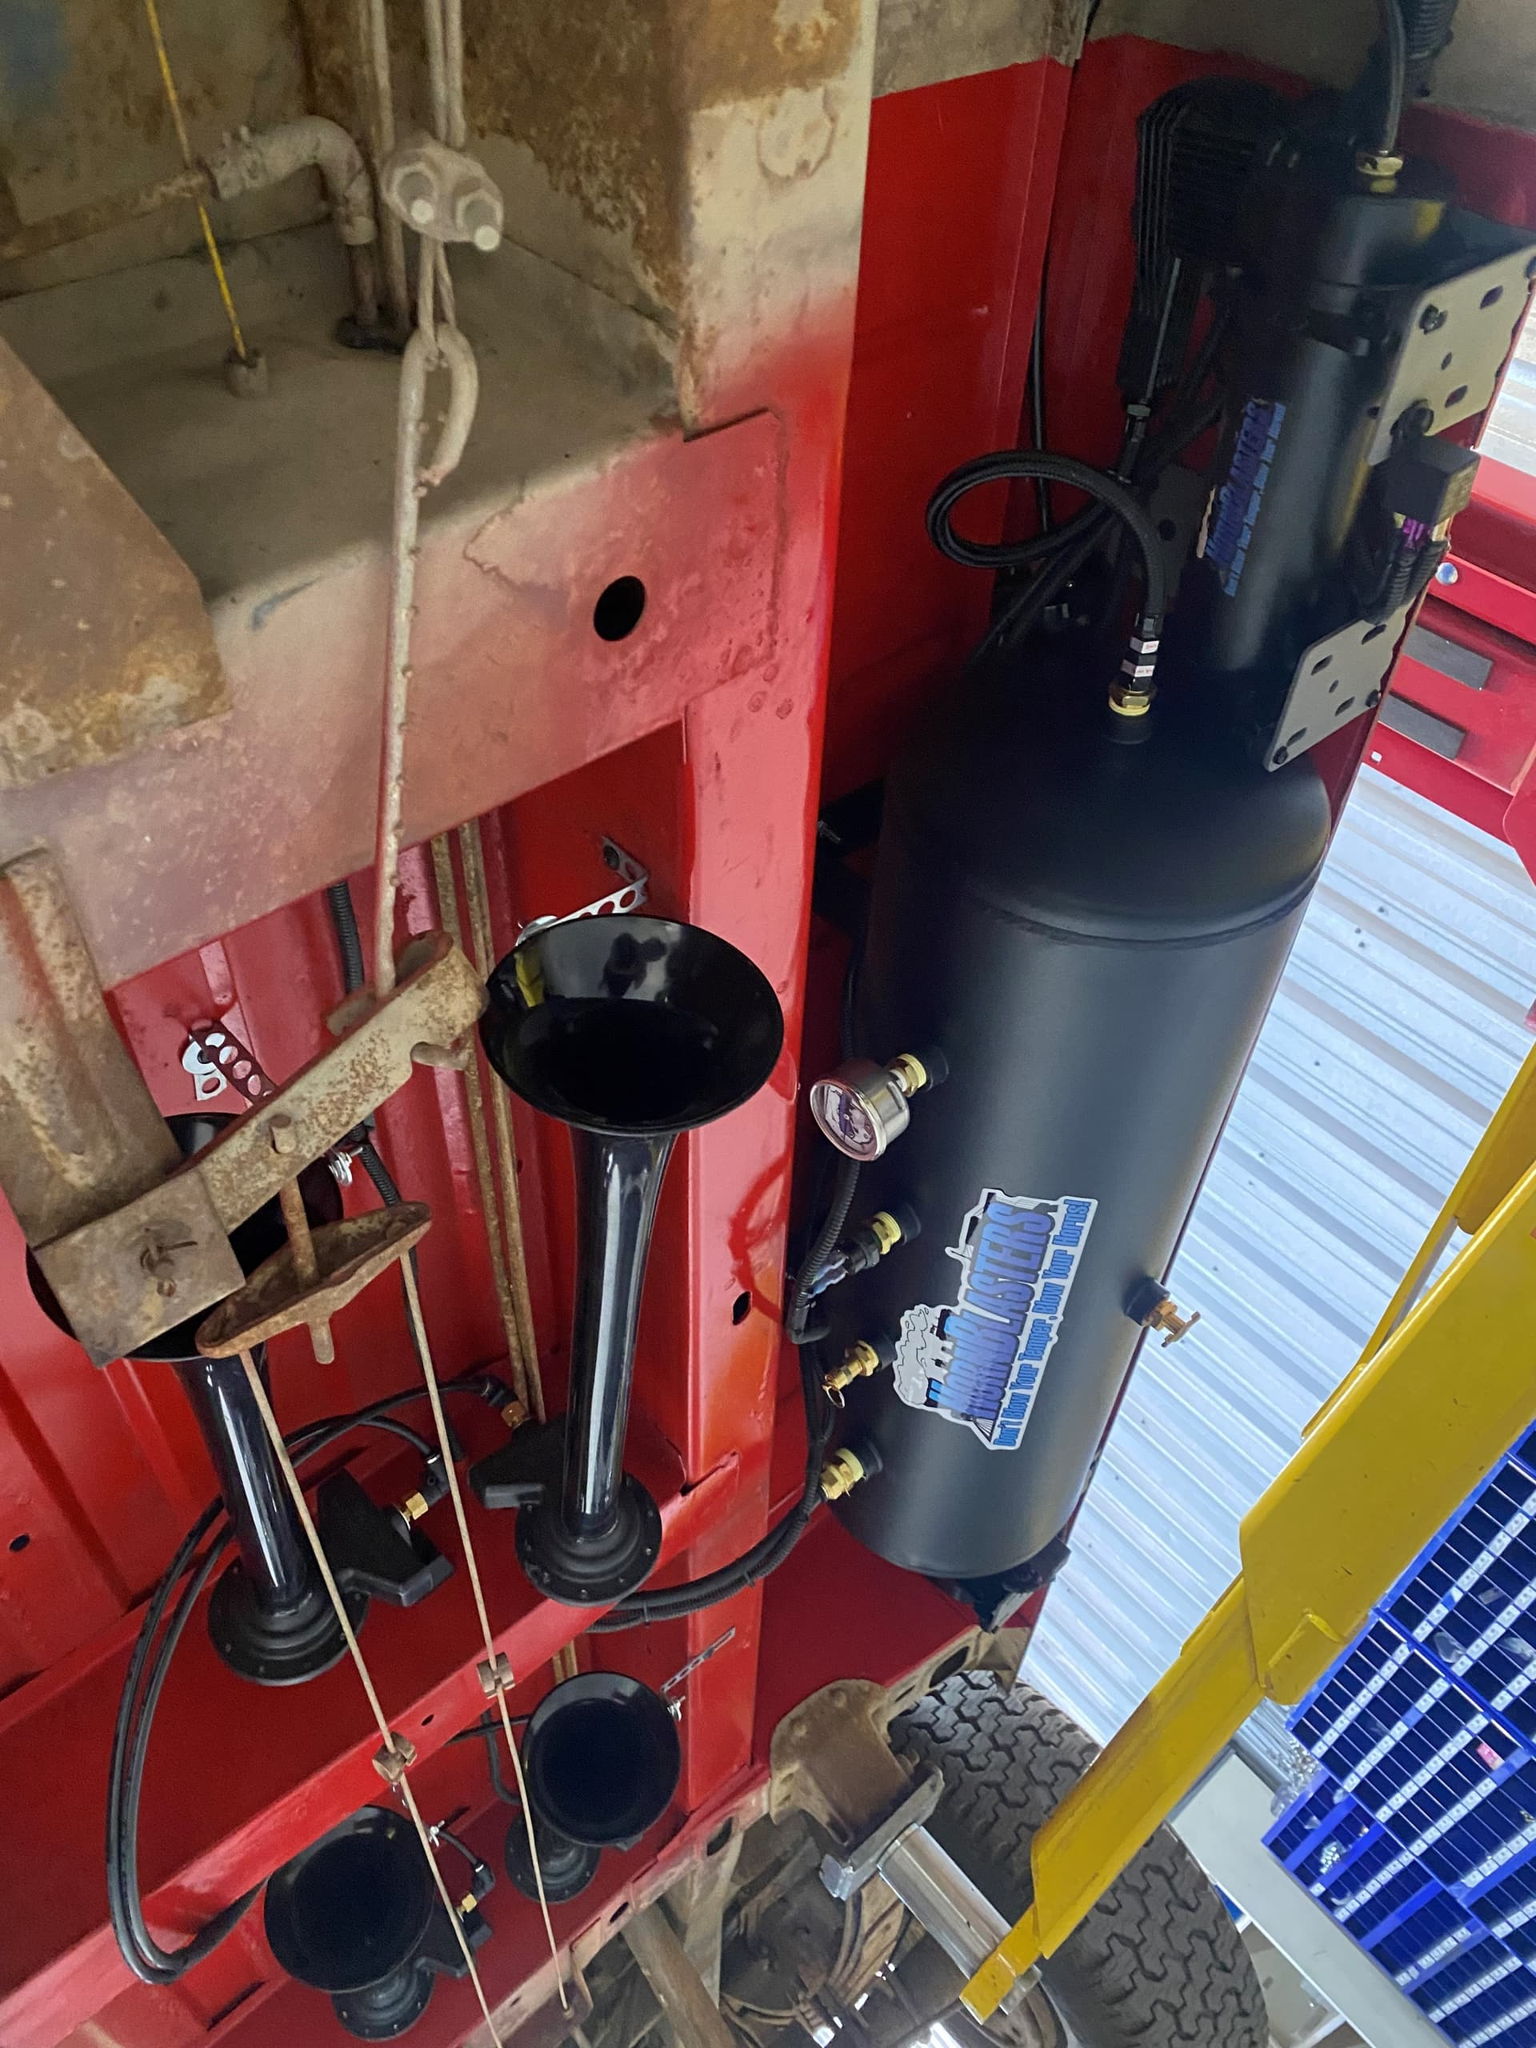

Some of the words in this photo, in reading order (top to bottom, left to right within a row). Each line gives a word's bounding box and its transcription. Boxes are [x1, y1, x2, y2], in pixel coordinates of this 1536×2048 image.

[1053, 1199, 1092, 1246] Horns!
[1043, 1250, 1075, 1279] Your
[1032, 1282, 1065, 1314] Blow
[1009, 1364, 1039, 1390] Your
[1001, 1393, 1031, 1420] Blow
[993, 1420, 1022, 1447] Don't
